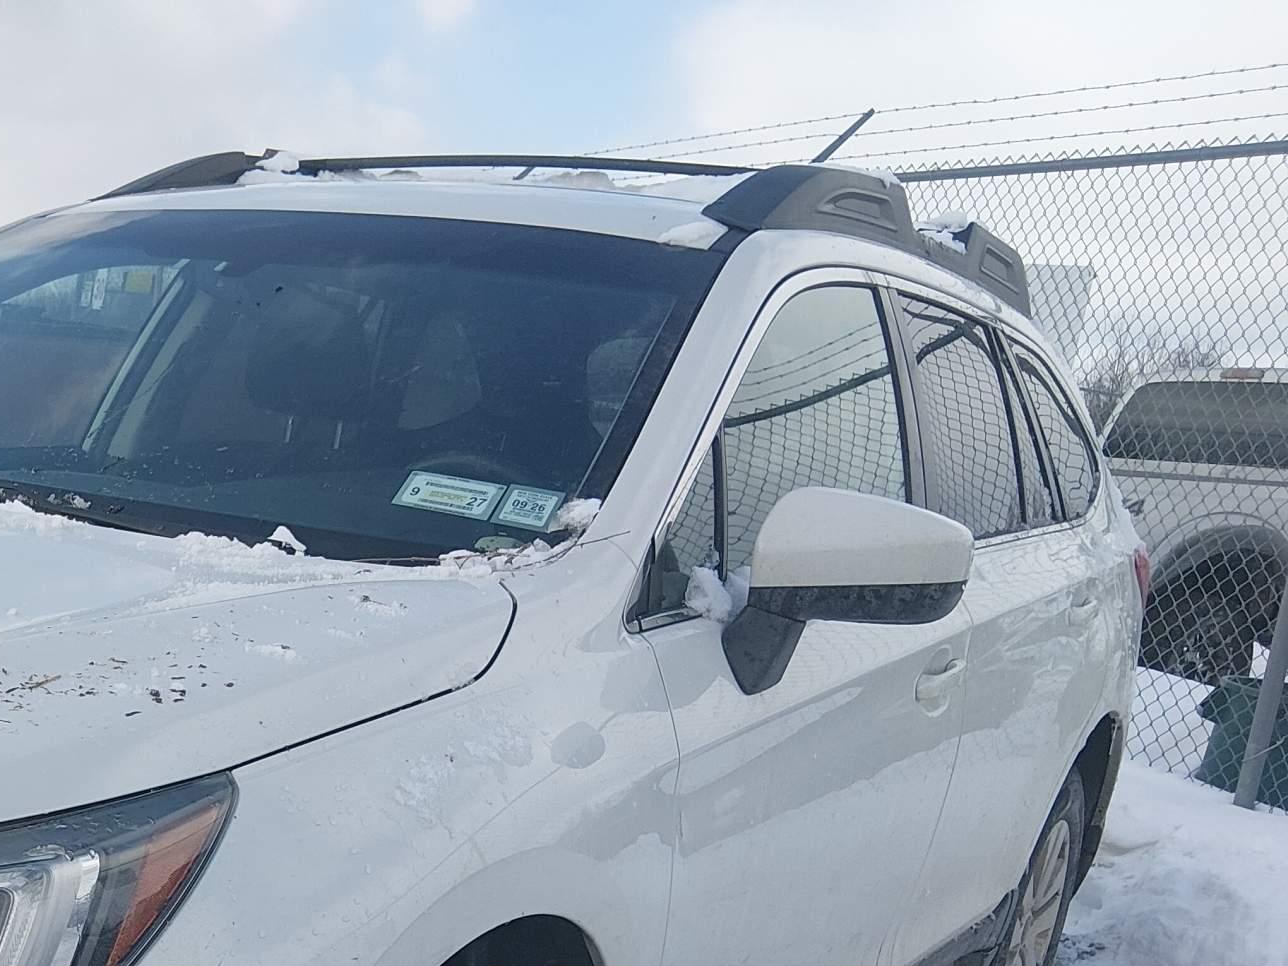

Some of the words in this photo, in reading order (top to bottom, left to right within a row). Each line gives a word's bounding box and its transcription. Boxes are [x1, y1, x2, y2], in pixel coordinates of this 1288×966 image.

[409, 486, 421, 497] 9
[465, 496, 488, 508] 27
[511, 499, 528, 509] 09
[529, 502, 547, 512] 26
